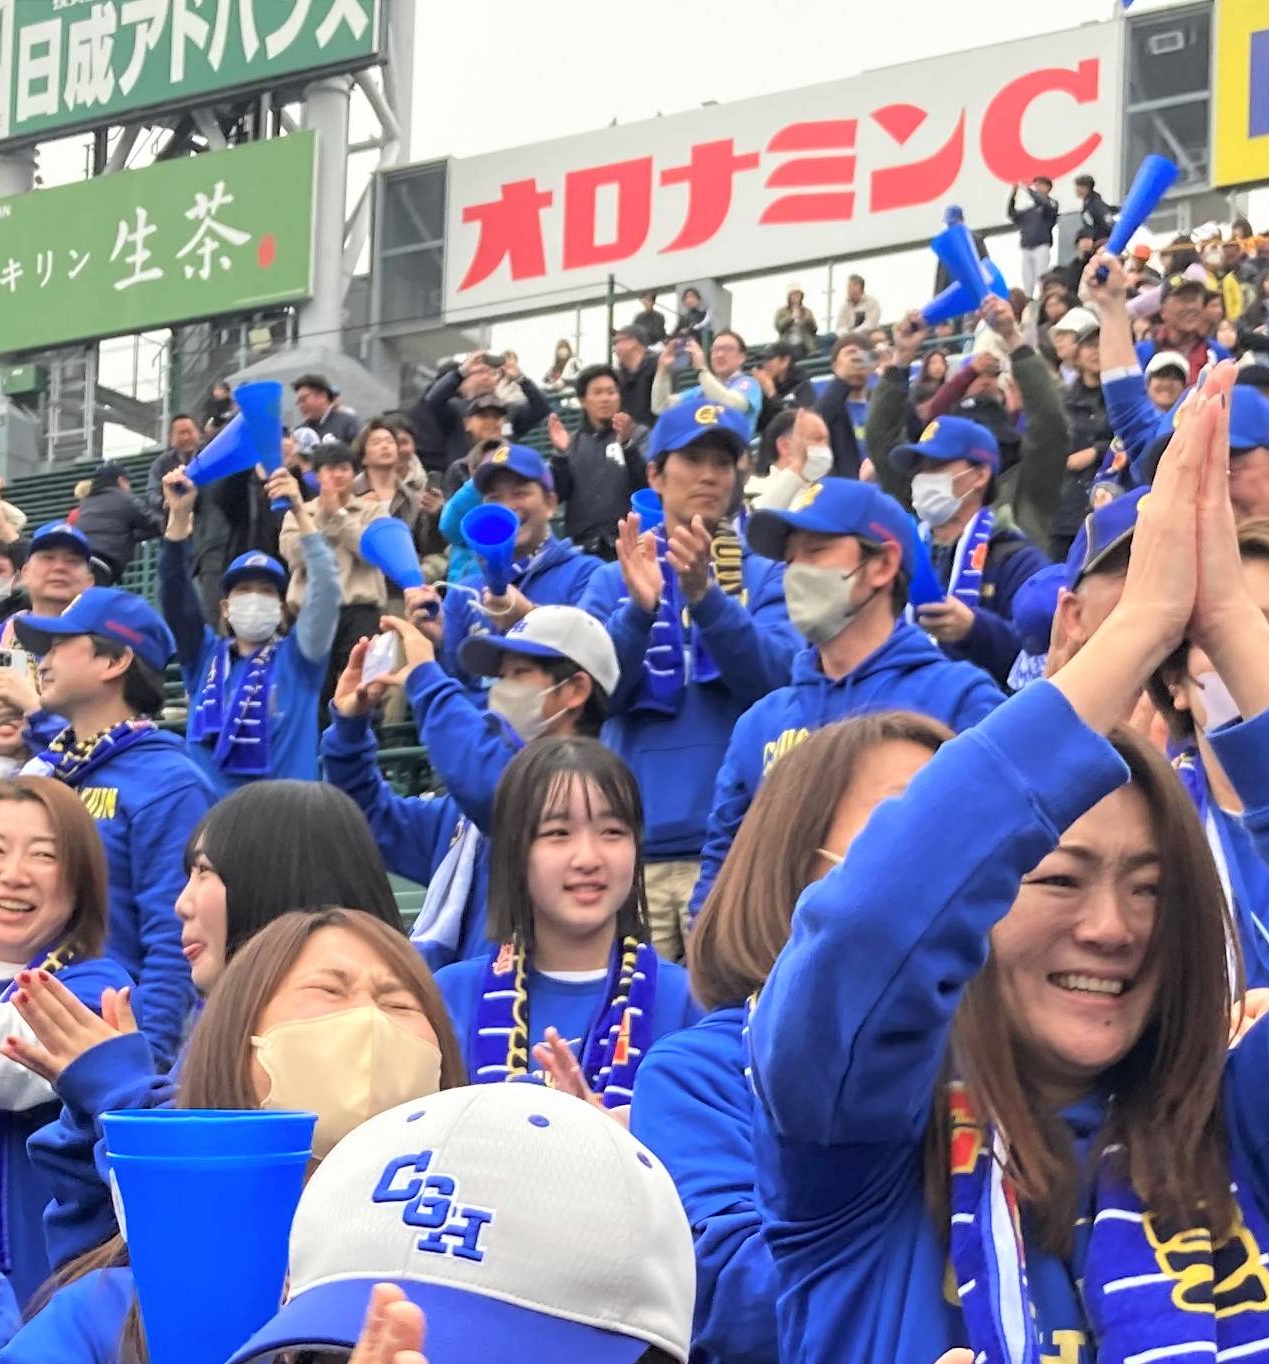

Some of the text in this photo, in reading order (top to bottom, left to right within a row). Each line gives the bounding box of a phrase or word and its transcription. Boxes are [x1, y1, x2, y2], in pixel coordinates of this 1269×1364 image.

[458, 58, 1102, 292] オロナミンC
[0, 181, 252, 292] キリン 生茶
[371, 1149, 493, 1263] CGH
